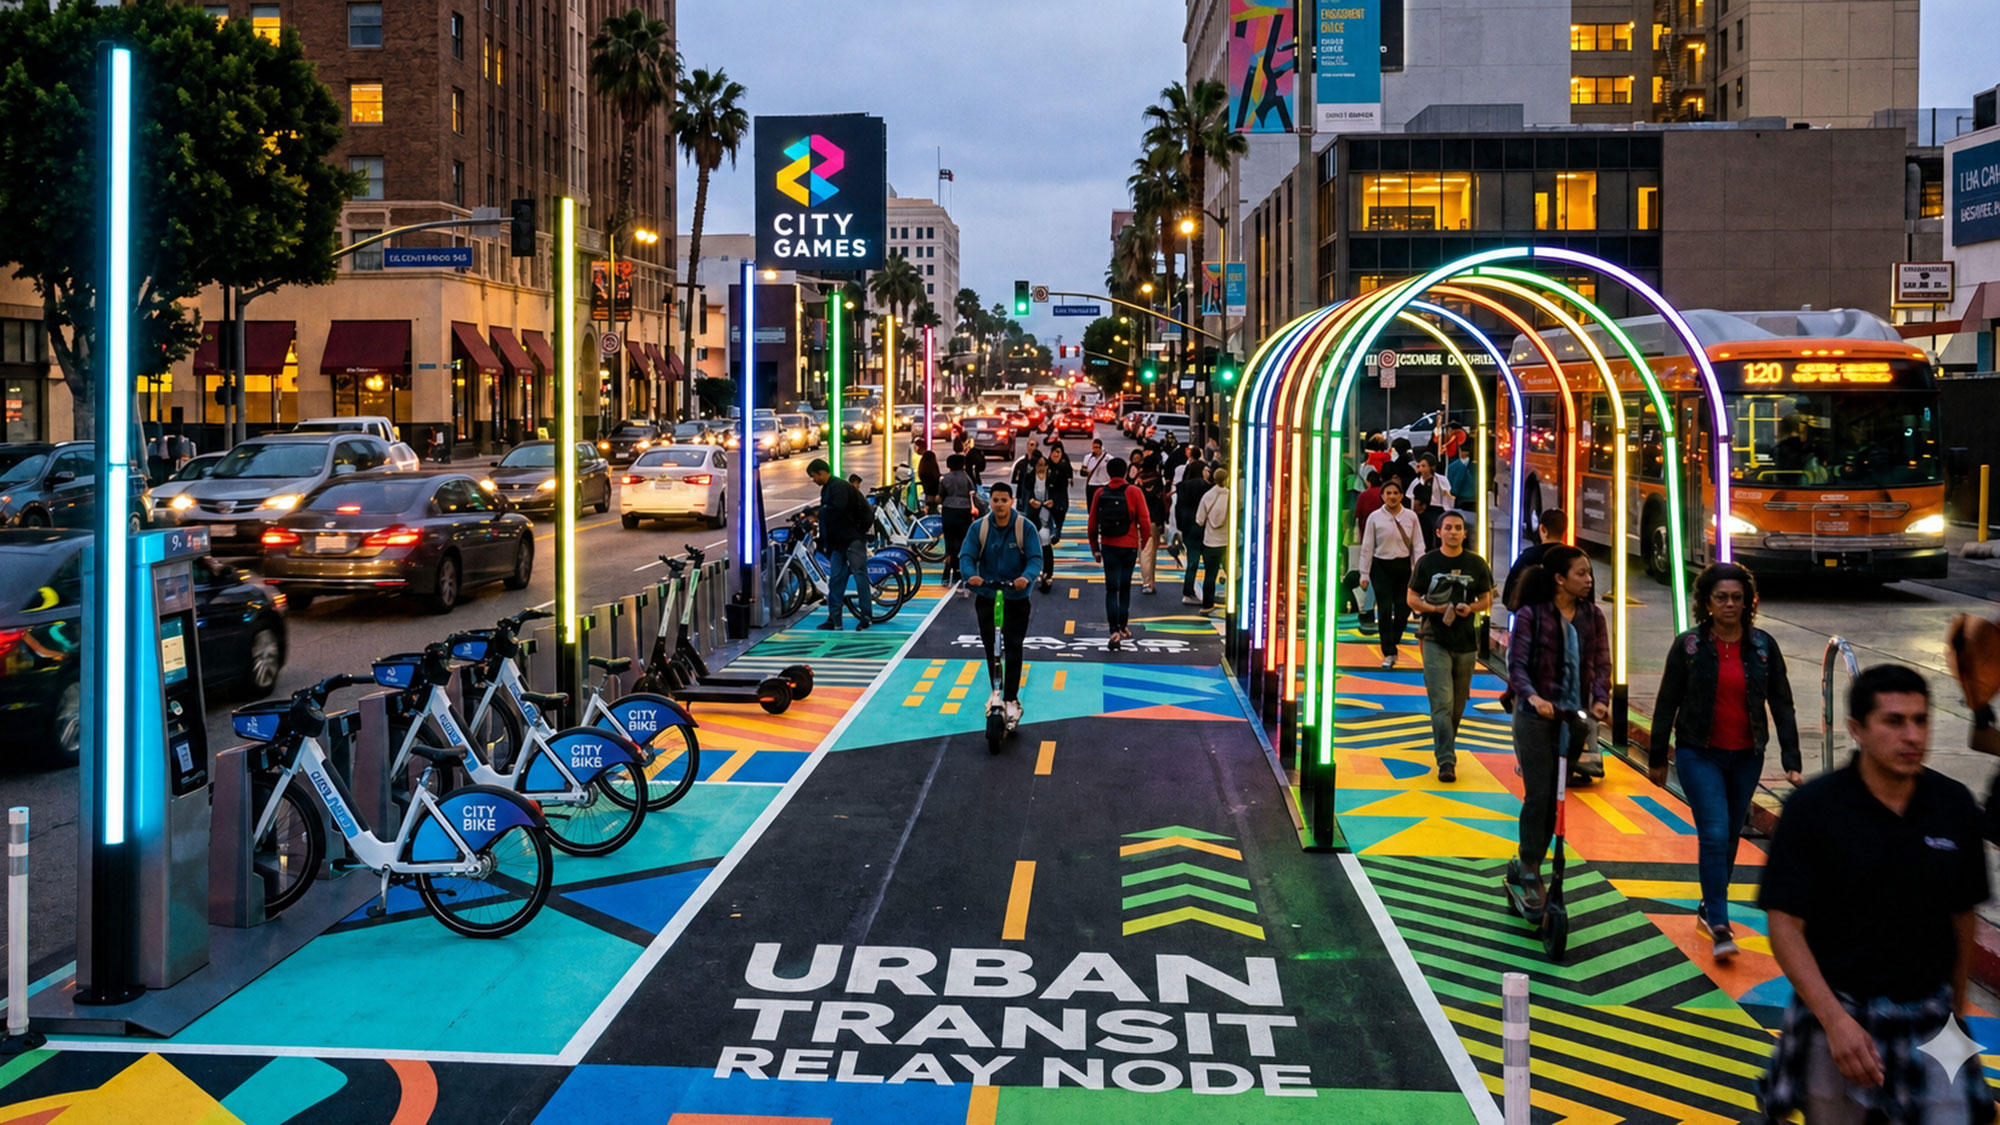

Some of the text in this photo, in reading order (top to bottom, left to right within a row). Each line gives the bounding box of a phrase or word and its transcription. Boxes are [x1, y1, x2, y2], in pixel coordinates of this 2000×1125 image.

[773, 213, 854, 236] CITY
[773, 238, 867, 258] GAMES
[1743, 362, 1783, 384] 120
[628, 709, 657, 720] CITY
[571, 744, 603, 756] CITY
[462, 805, 496, 818] CITY
[463, 818, 496, 831] BIKE
[744, 942, 1284, 1007] URBAN
[733, 998, 1298, 1057] TRANSIT
[713, 1046, 1318, 1098] RELAY NODE
